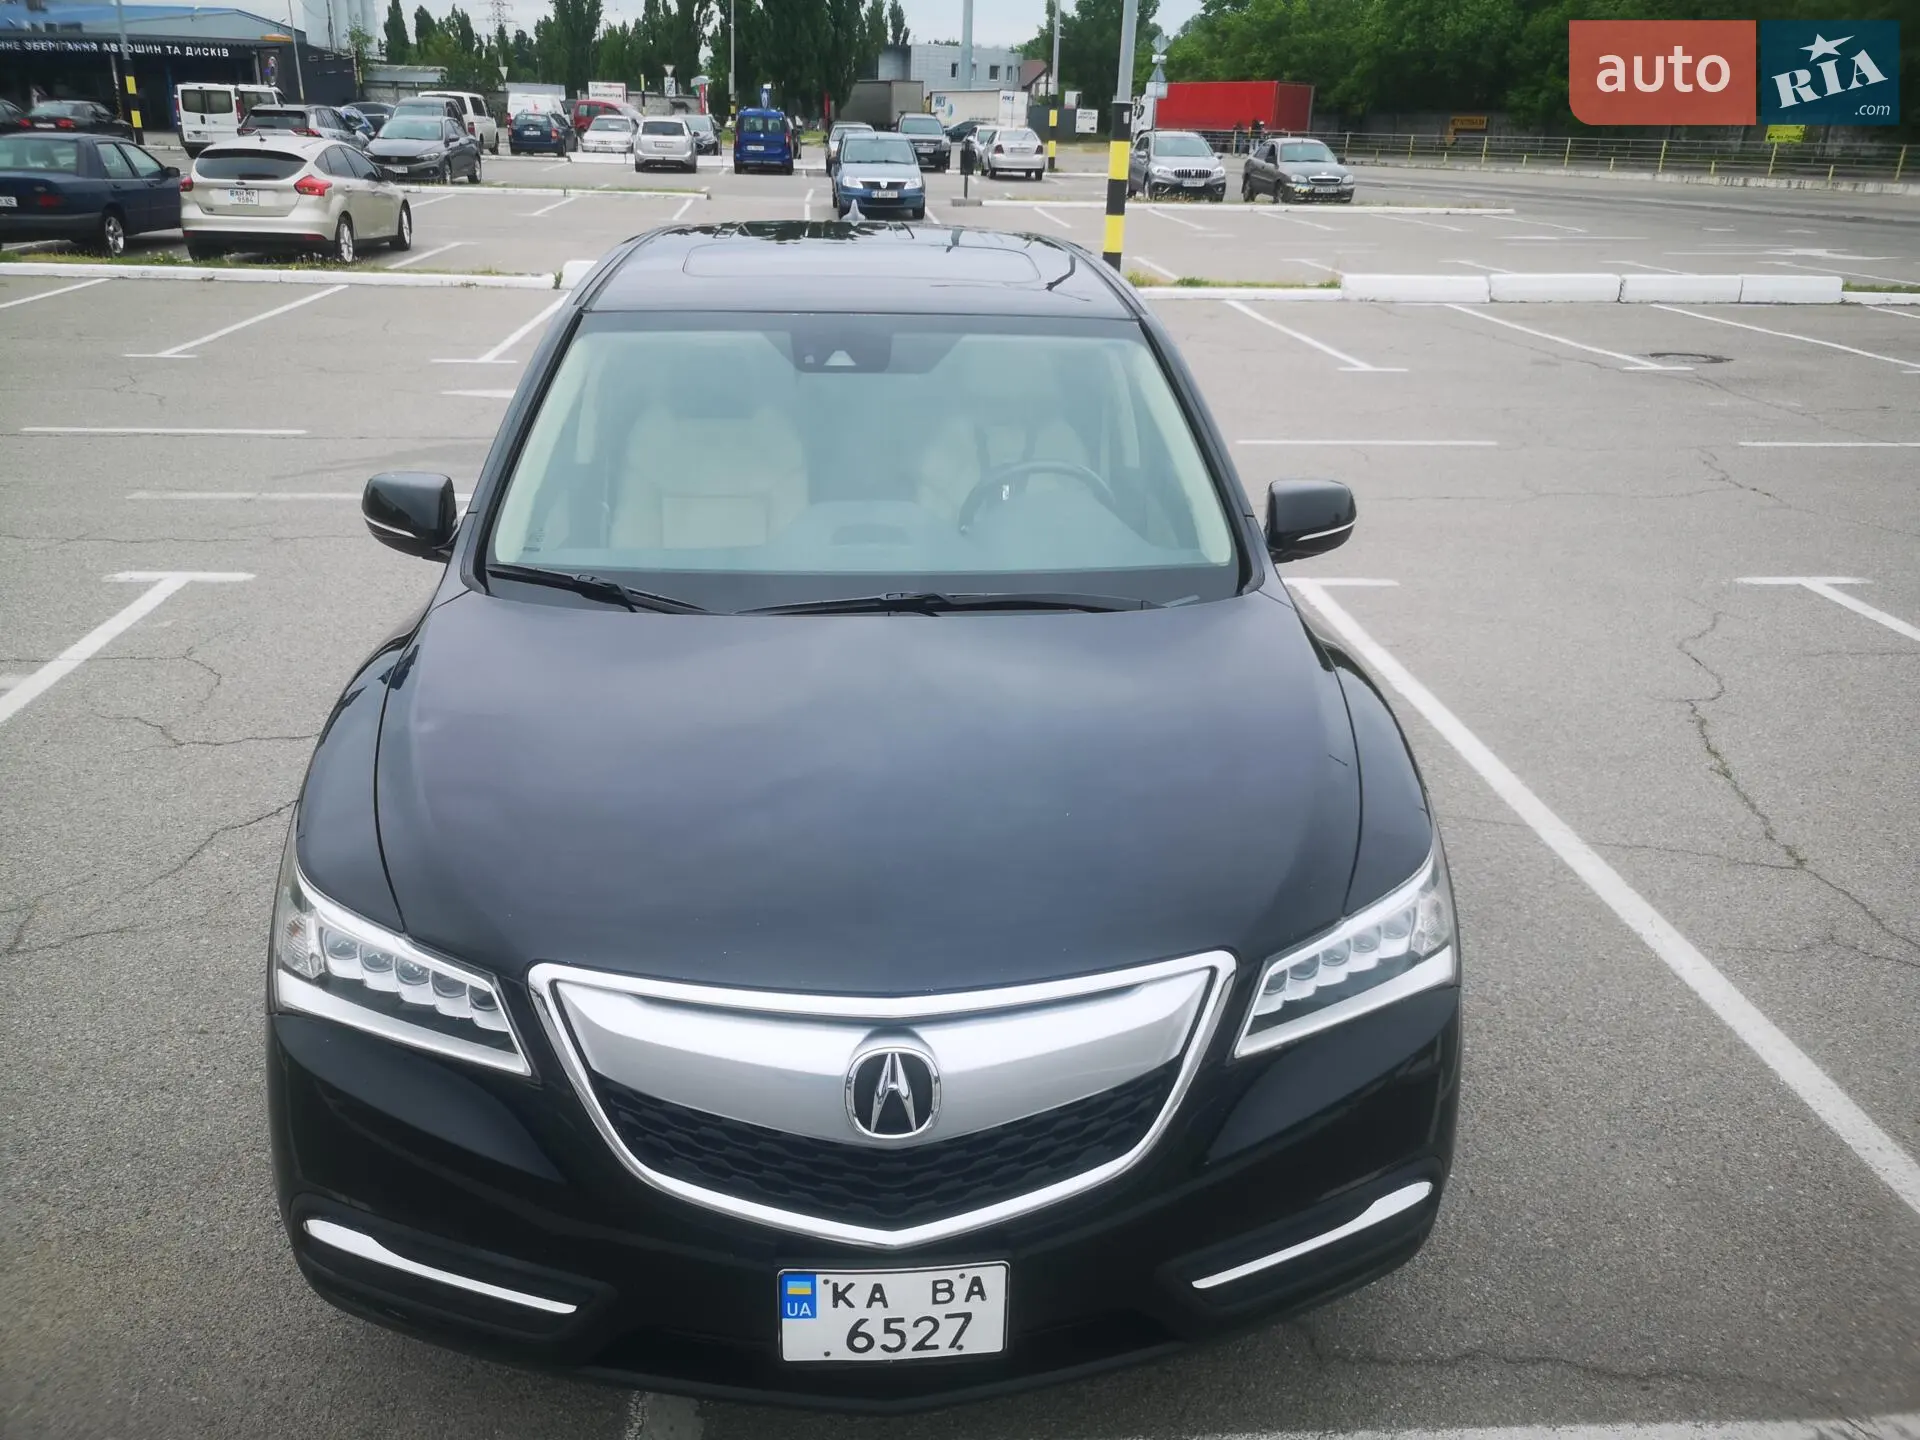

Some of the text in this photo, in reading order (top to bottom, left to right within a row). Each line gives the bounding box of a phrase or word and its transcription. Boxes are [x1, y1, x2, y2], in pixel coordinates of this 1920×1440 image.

[23, 40, 98, 52] ЗБЕРІГАННЯ
[166, 45, 181, 55] ТА
[185, 46, 229, 57] ДИСКІВ
[831, 1275, 987, 1309] KA BA
[786, 1302, 812, 1317] UA
[845, 1312, 973, 1354] 6527
